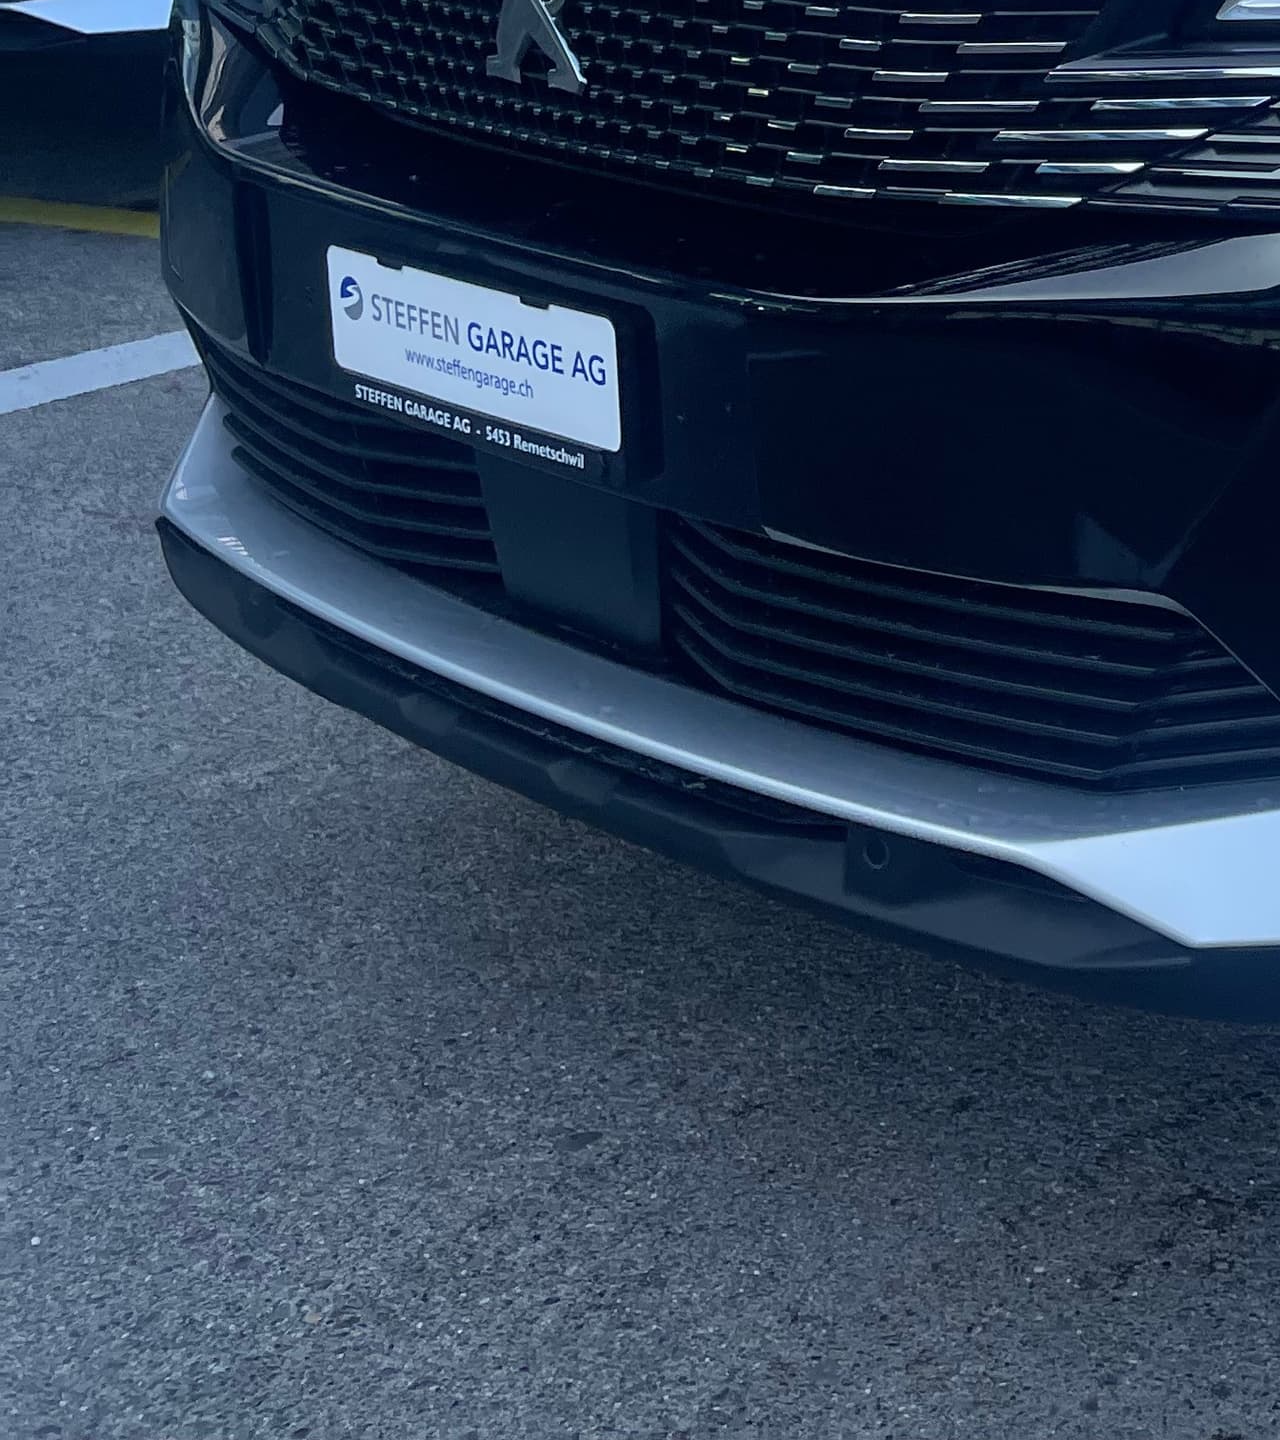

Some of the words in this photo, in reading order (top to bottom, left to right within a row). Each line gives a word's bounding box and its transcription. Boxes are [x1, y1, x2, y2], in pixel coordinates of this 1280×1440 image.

[371, 293, 460, 345] STEFFEN
[467, 321, 564, 375] GARAGE
[571, 350, 607, 386] AG
[404, 345, 535, 400] www.steffengarage.ch
[354, 382, 403, 413] STEFFEN
[404, 398, 451, 429] GARAGE
[449, 415, 471, 435] AG
[485, 424, 512, 448] 5453
[513, 431, 585, 471] Remetschwil
